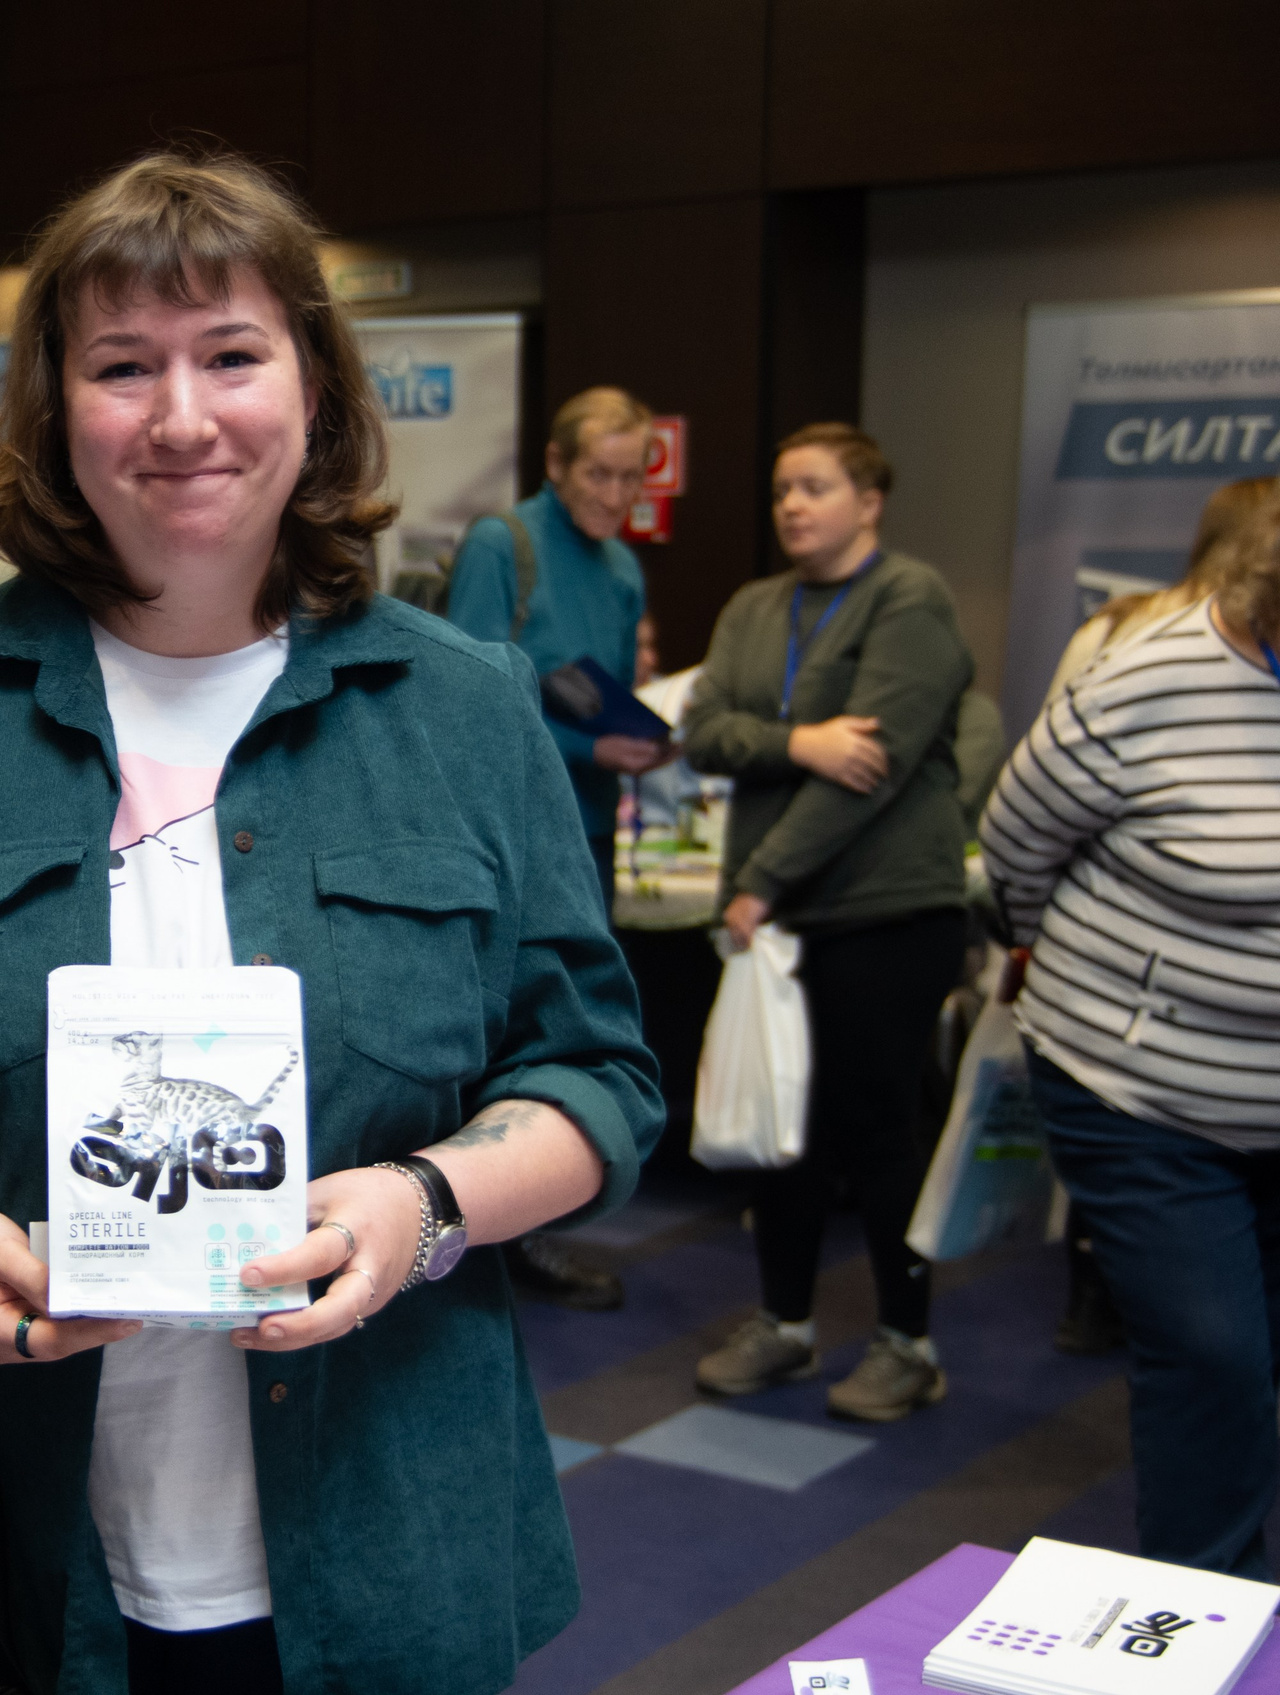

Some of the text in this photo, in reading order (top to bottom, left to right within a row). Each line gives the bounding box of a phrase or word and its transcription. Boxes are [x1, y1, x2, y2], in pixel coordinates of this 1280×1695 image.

[202, 1196, 242, 1204] technology
[69, 1211, 132, 1221] SPECIAL LINE
[69, 1222, 146, 1238] STERILE
